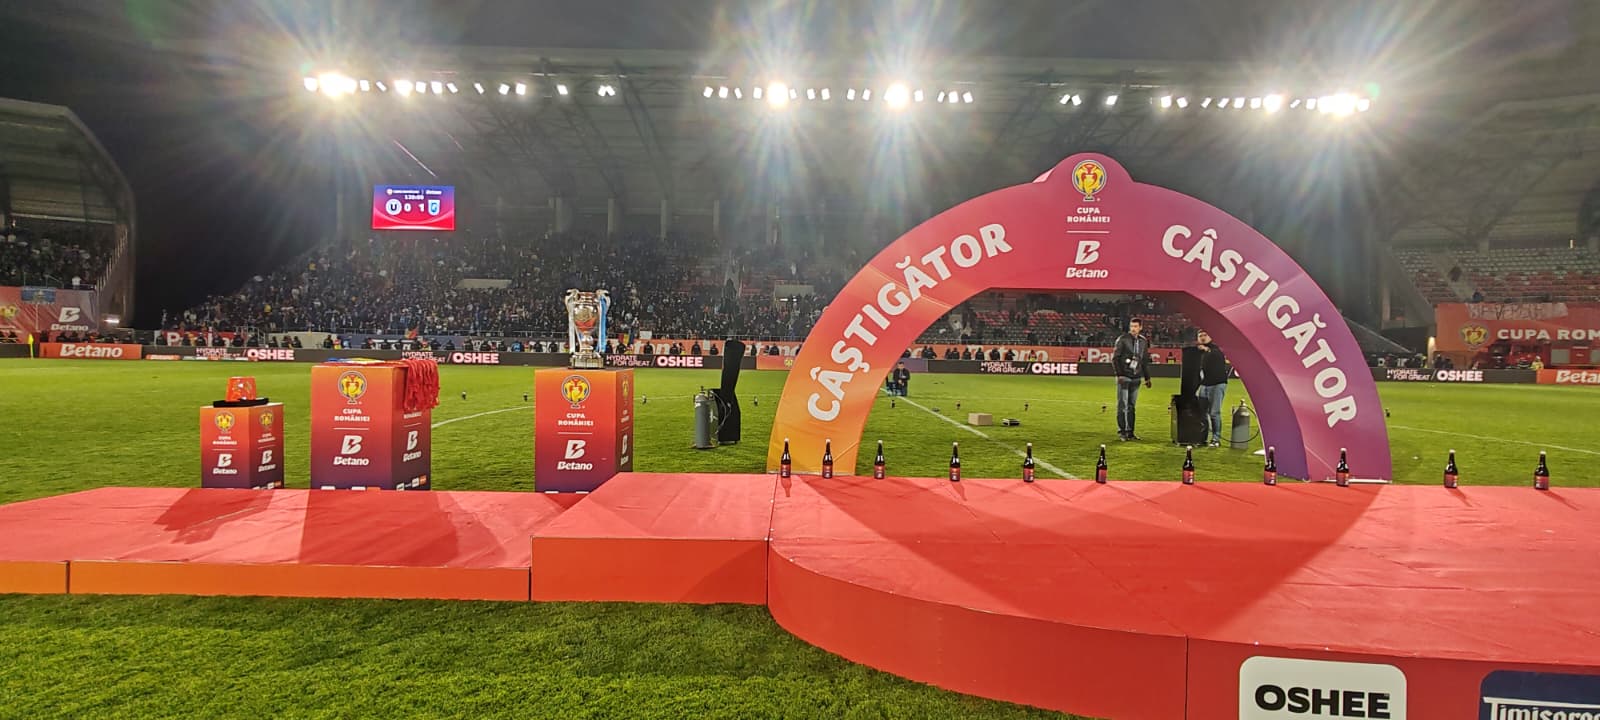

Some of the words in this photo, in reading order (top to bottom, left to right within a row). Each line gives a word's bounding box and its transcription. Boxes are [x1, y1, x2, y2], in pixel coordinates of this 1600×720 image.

[404, 203, 411, 212] 0
[419, 203, 425, 212] 1
[1066, 214, 1110, 223] ROMÂNIEI
[1066, 267, 1108, 278] Betano
[1497, 329, 1550, 340] CUPA
[60, 344, 123, 357] Betano
[248, 349, 295, 360] OSHEE
[452, 352, 499, 363] OSHEE
[657, 356, 703, 367] OSHEE
[1031, 363, 1079, 374] OSHEE
[1437, 370, 1483, 381] OSHEE
[1556, 369, 1600, 383] Beta
[333, 456, 369, 465] Betano
[557, 461, 593, 470] Betano
[1255, 685, 1391, 720] OSHEE
